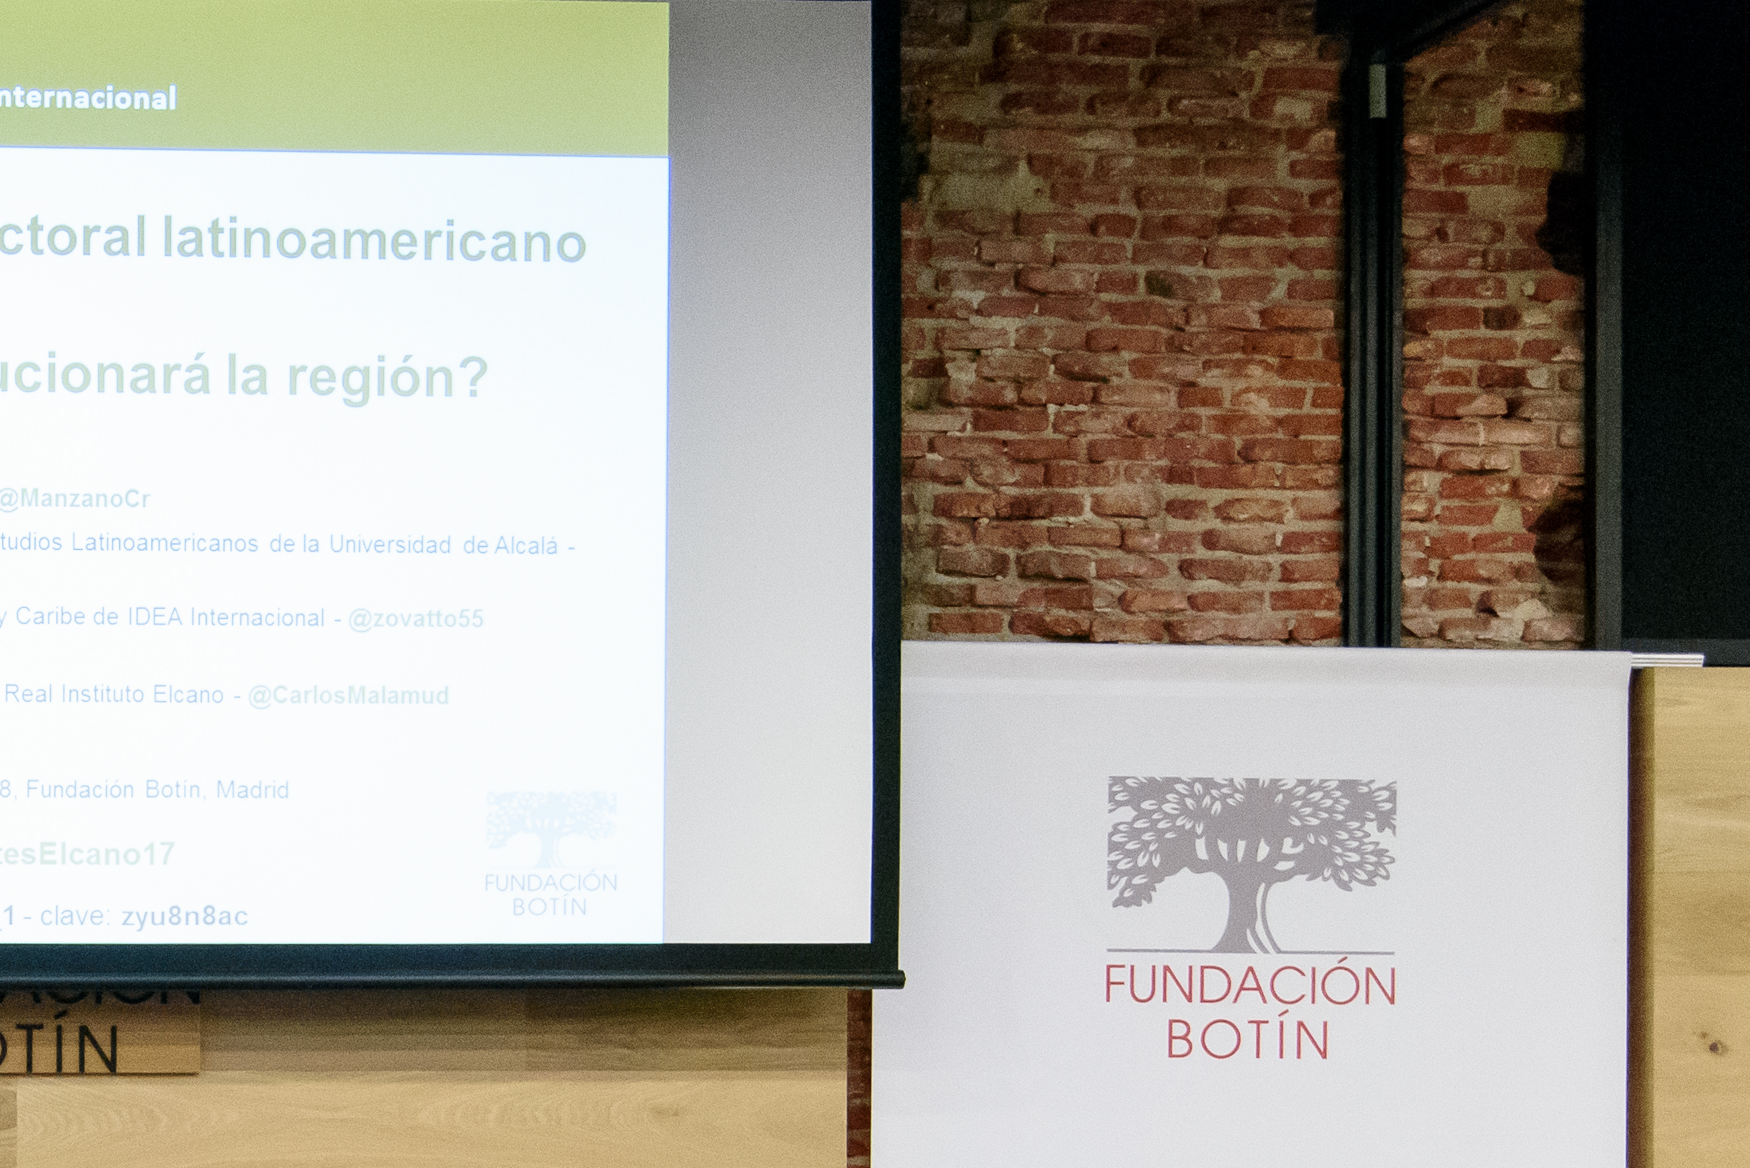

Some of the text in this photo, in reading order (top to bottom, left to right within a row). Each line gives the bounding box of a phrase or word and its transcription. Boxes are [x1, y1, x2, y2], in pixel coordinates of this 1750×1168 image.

[164, 215, 587, 263] latinoamericano
[228, 353, 268, 395] la
[289, 354, 488, 408] región?
[72, 532, 259, 553] Latinoamericanos
[270, 534, 295, 553] de
[303, 534, 319, 553] la
[330, 534, 451, 554] Universidad
[463, 535, 489, 554] de
[494, 535, 558, 555] Alcalá
[16, 606, 86, 625] Caribe
[93, 607, 119, 626] de
[129, 606, 183, 626] IDEA
[191, 607, 324, 627] Internacional
[348, 608, 484, 633] @zovatto55
[5, 683, 52, 703] Real
[62, 684, 145, 703] Instituto
[153, 684, 224, 704] Elcano
[248, 684, 449, 710] @CarlosMalamud
[27, 779, 134, 799] Fundación
[146, 779, 206, 799] Botín,
[217, 780, 289, 799] Madrid
[484, 869, 618, 891] FUNDACIÓN
[40, 906, 112, 926] clave:
[122, 904, 248, 932] zyu8n8ac
[512, 895, 587, 916] BOTÍN
[1106, 956, 1396, 1005] FUNDACIÓN
[1168, 1009, 1328, 1059] BOTÍN
